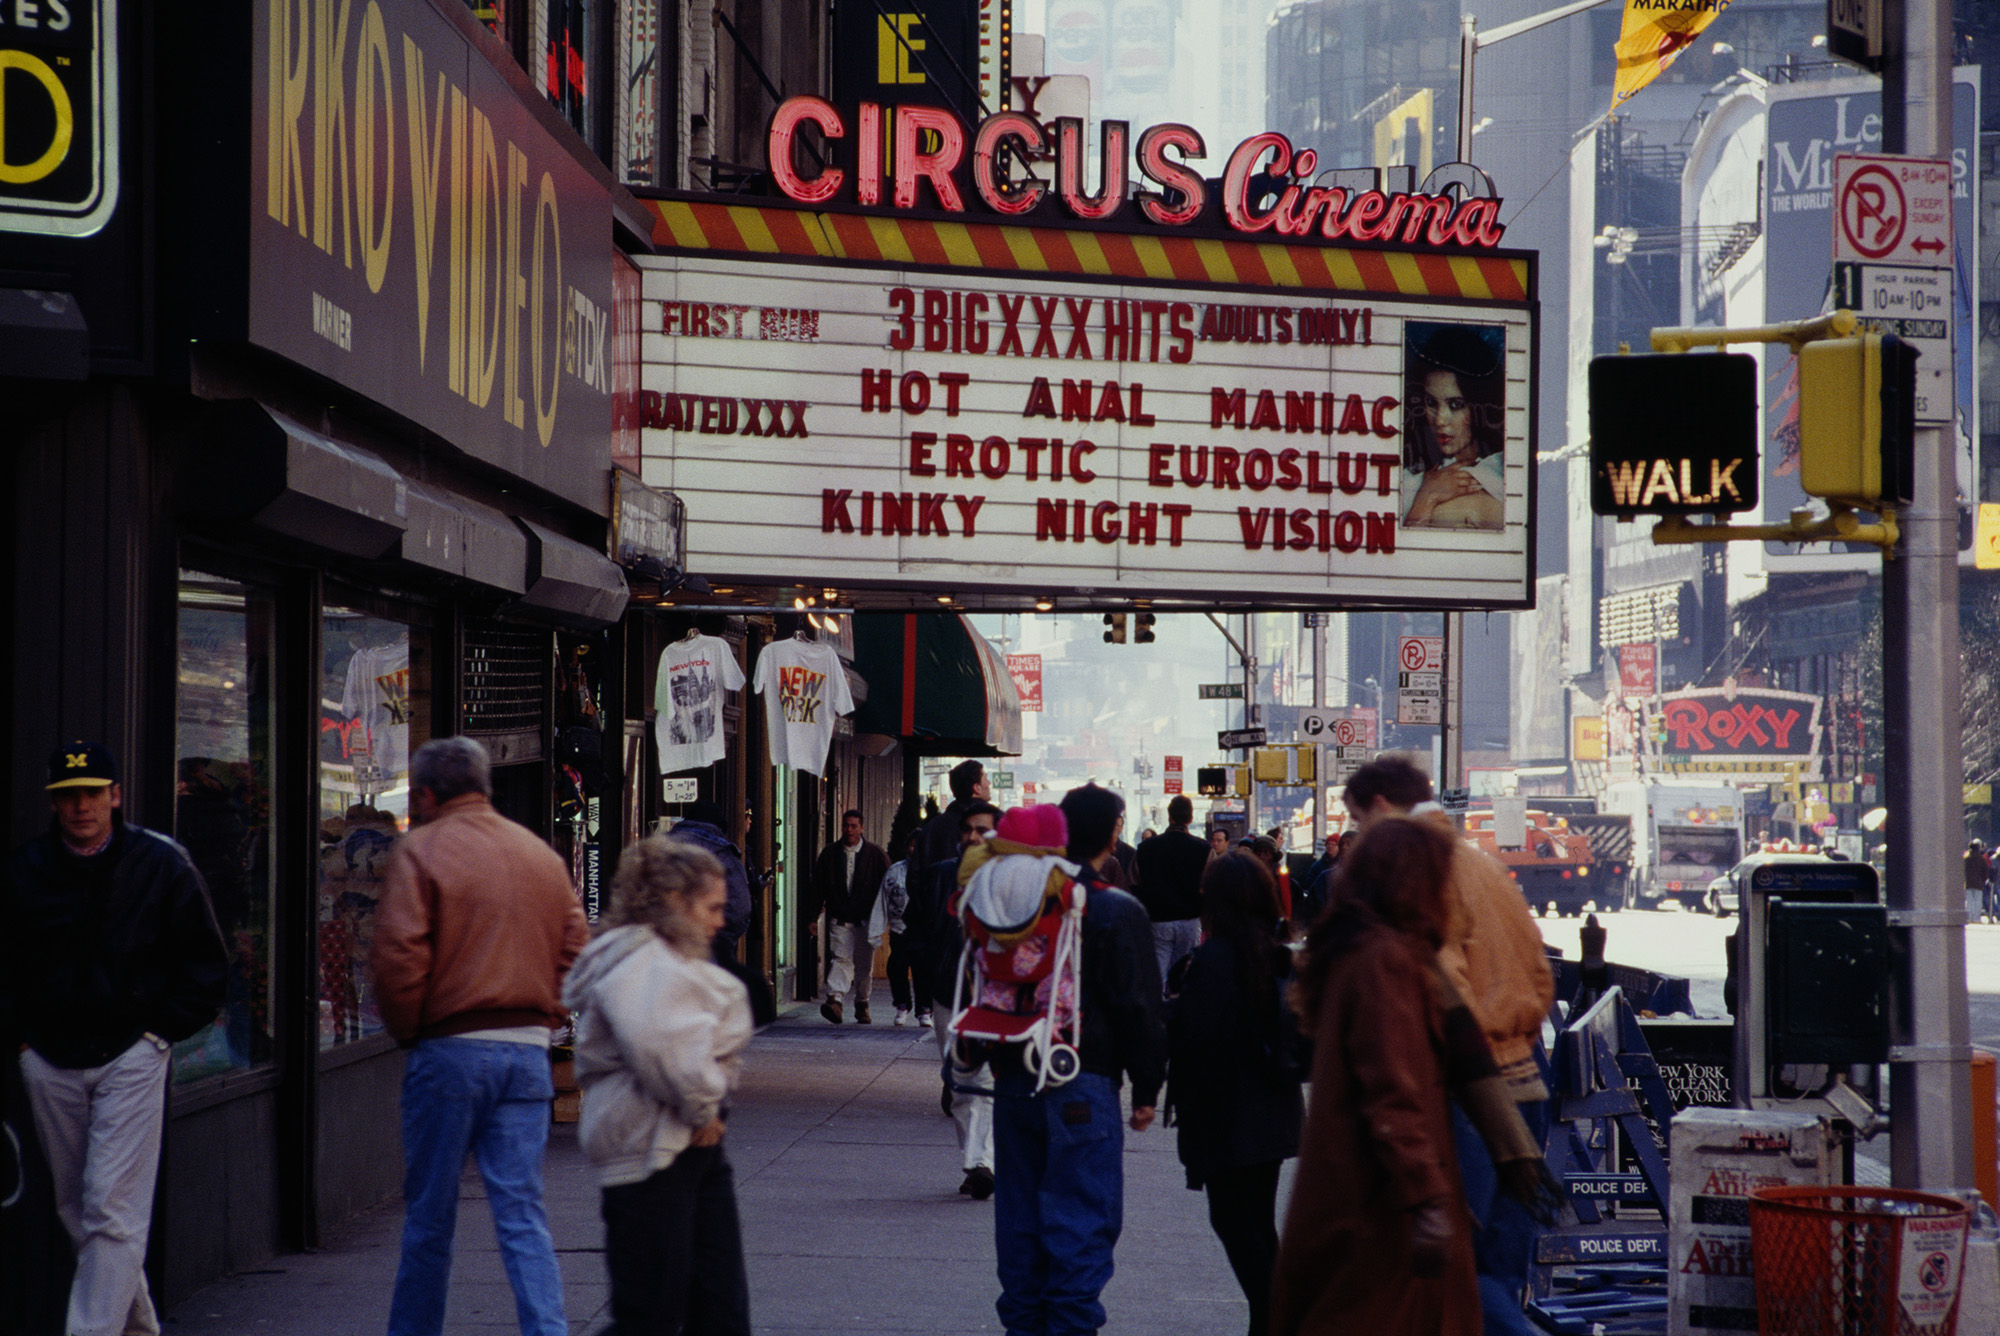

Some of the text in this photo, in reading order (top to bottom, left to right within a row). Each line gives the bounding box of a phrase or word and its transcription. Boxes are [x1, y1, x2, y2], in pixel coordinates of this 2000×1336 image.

[0, 0, 70, 30] ES
[1834, 97, 1882, 144] Le
[768, 95, 1505, 247] CIRCUS Cinema
[1773, 196, 1791, 212] THE
[268, 0, 395, 293] RKO
[403, 33, 562, 447] VIDEO
[1844, 265, 1853, 306] 1
[1875, 275, 1938, 285] HOUR PARKING
[312, 291, 352, 352] WARNER
[663, 301, 819, 342] FIRST RUN
[889, 288, 1373, 364] 3 BIG XXX HITS ADULTS ONLY!
[1904, 319, 1945, 337] SUNDAY
[574, 289, 607, 395] TDK
[641, 389, 808, 438] RATED XXX
[861, 368, 1400, 438] HOT ANAL MANIAC
[910, 431, 1400, 496] EROTIC EUROSLUT
[1606, 458, 1743, 506] WALK
[822, 488, 1395, 554] KINKY NIGHT VISION
[669, 661, 689, 673] NEW
[1008, 656, 1040, 664] TIMES
[779, 666, 827, 699] NEW
[1208, 686, 1216, 697] W
[1218, 686, 1232, 697] 48
[779, 695, 821, 724] YORK
[1662, 698, 1801, 750] ROXY
[1225, 736, 1240, 744] ONE
[66, 753, 88, 768] M
[667, 781, 673, 790] 5
[589, 803, 599, 823] WAY
[588, 850, 599, 924] MANHATTAN
[1656, 1063, 1724, 1079] EW YORK
[1668, 1078, 1720, 1090] CLEAN
[1684, 1090, 1731, 1105] YORK.
[1572, 1182, 1618, 1194] POLICE
[1720, 1171, 1738, 1180] The
[1580, 1239, 1662, 1253] POLICE DEPT.
